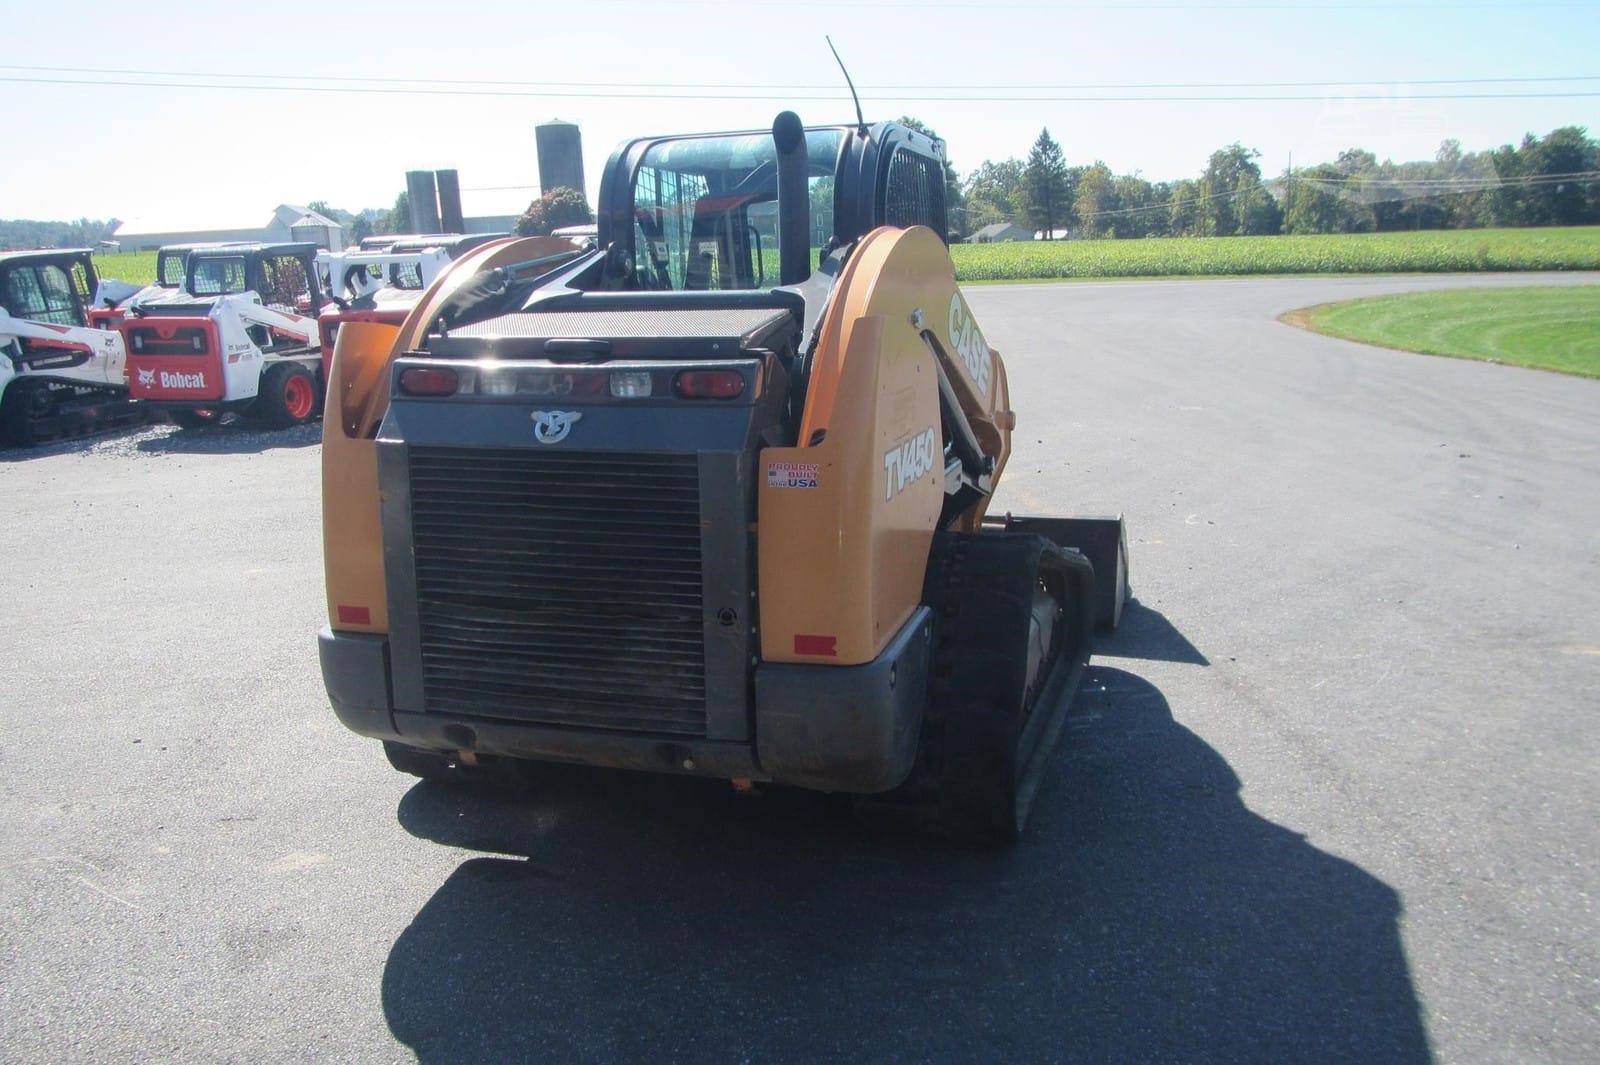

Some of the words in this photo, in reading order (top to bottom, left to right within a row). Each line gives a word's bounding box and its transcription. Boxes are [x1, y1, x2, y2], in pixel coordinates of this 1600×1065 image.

[948, 292, 991, 397] CASE
[160, 371, 206, 389] Bobcat
[769, 463, 818, 471] PROUDLY
[885, 426, 935, 501] TV450
[788, 471, 818, 479] BUILT
[788, 479, 817, 488] USA
